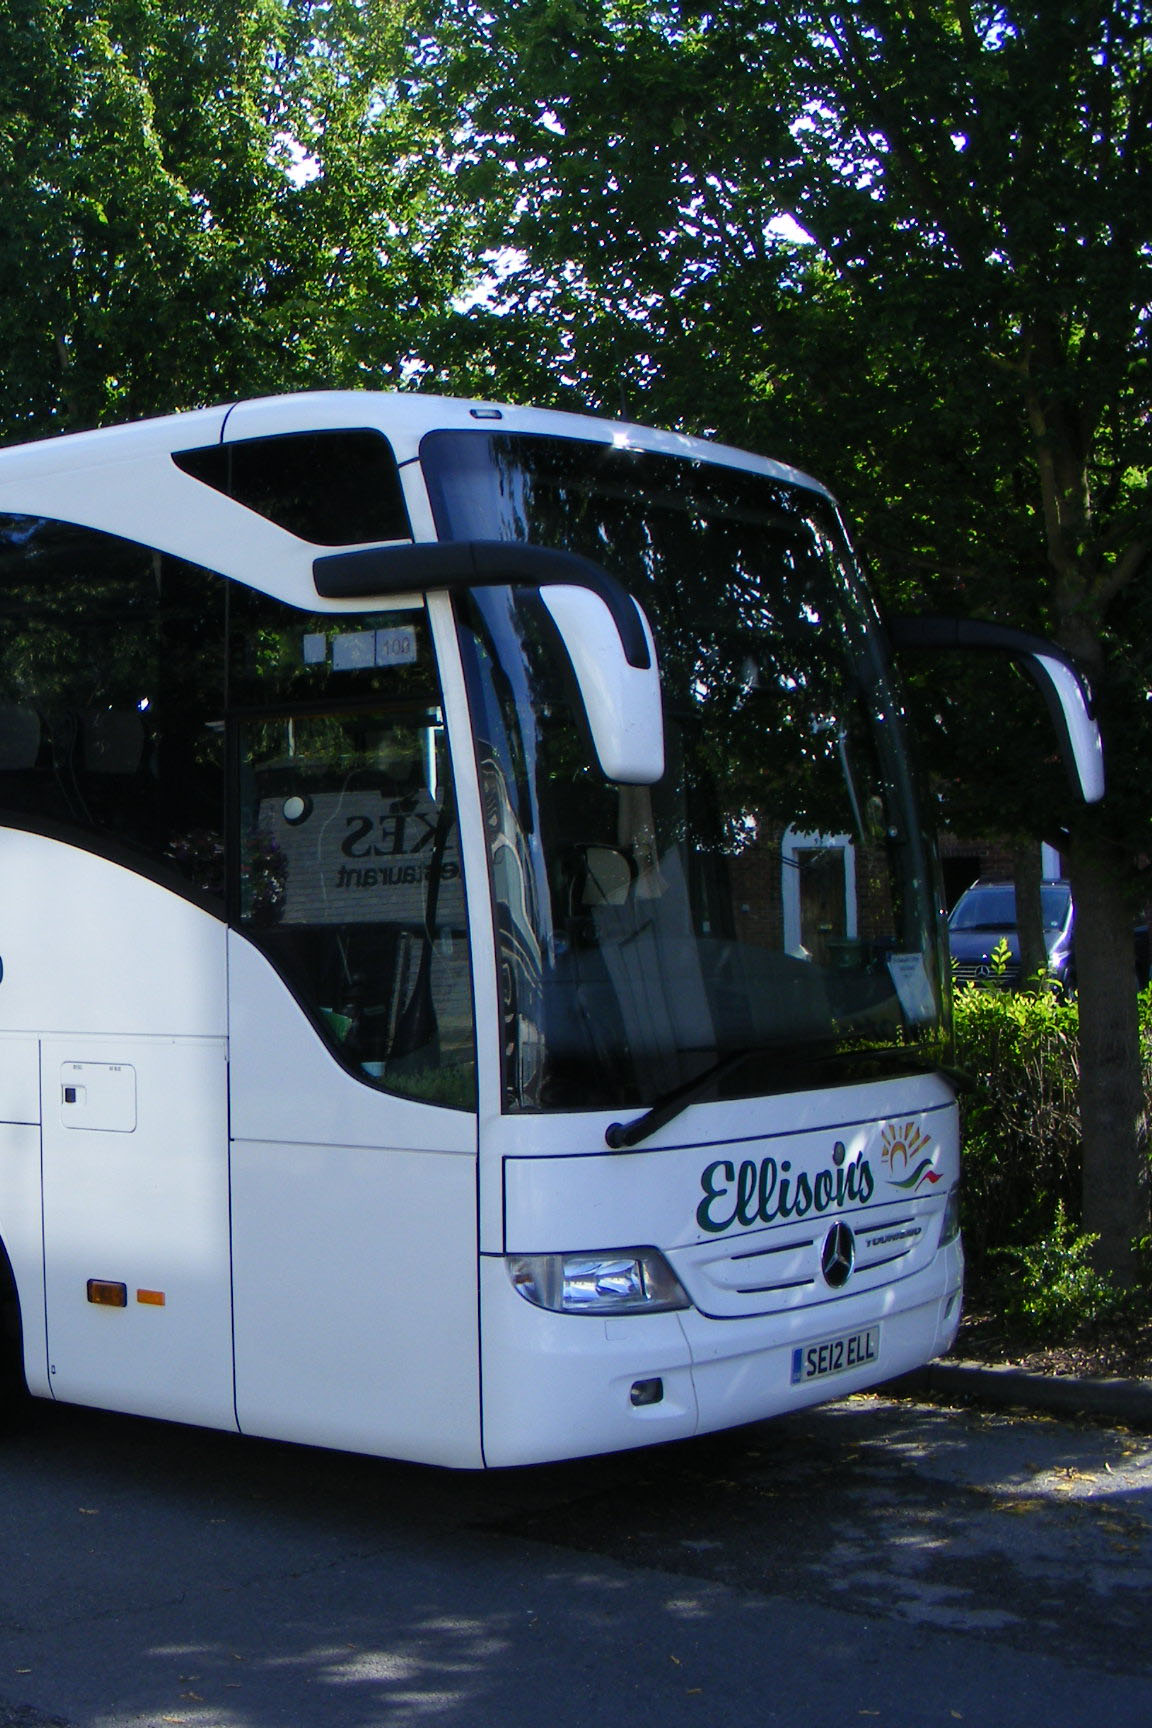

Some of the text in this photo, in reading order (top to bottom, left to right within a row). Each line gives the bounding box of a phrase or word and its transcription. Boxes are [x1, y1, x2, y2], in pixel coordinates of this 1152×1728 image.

[696, 1152, 874, 1233] Ellison's
[806, 1332, 874, 1376] SE12 ELL
